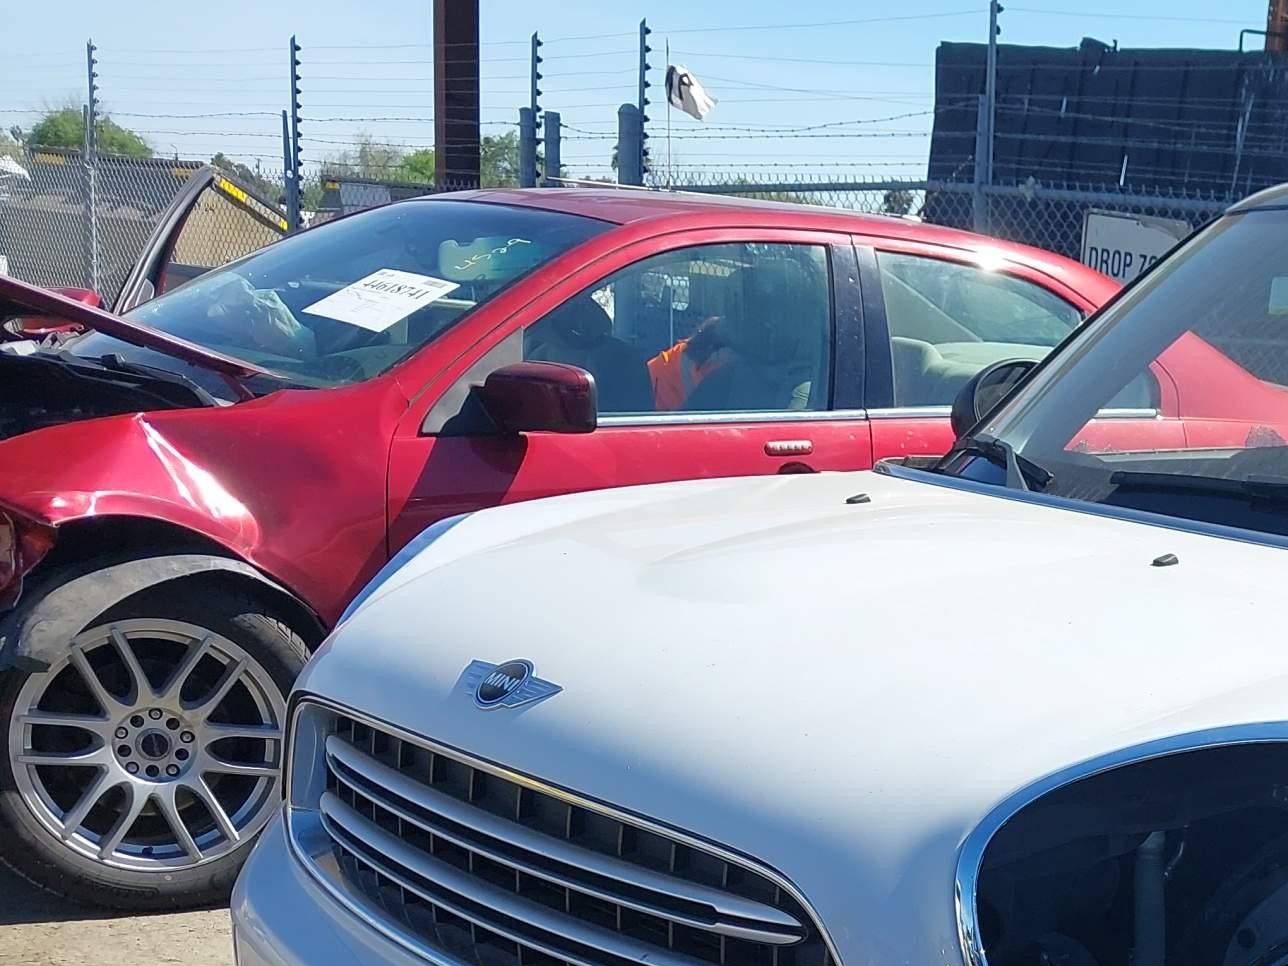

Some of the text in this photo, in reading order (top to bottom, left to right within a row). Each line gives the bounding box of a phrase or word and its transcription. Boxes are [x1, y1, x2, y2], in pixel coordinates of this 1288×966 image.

[1088, 247, 1133, 279] DROP
[363, 279, 431, 300] 44618741
[484, 671, 521, 692] MINI
